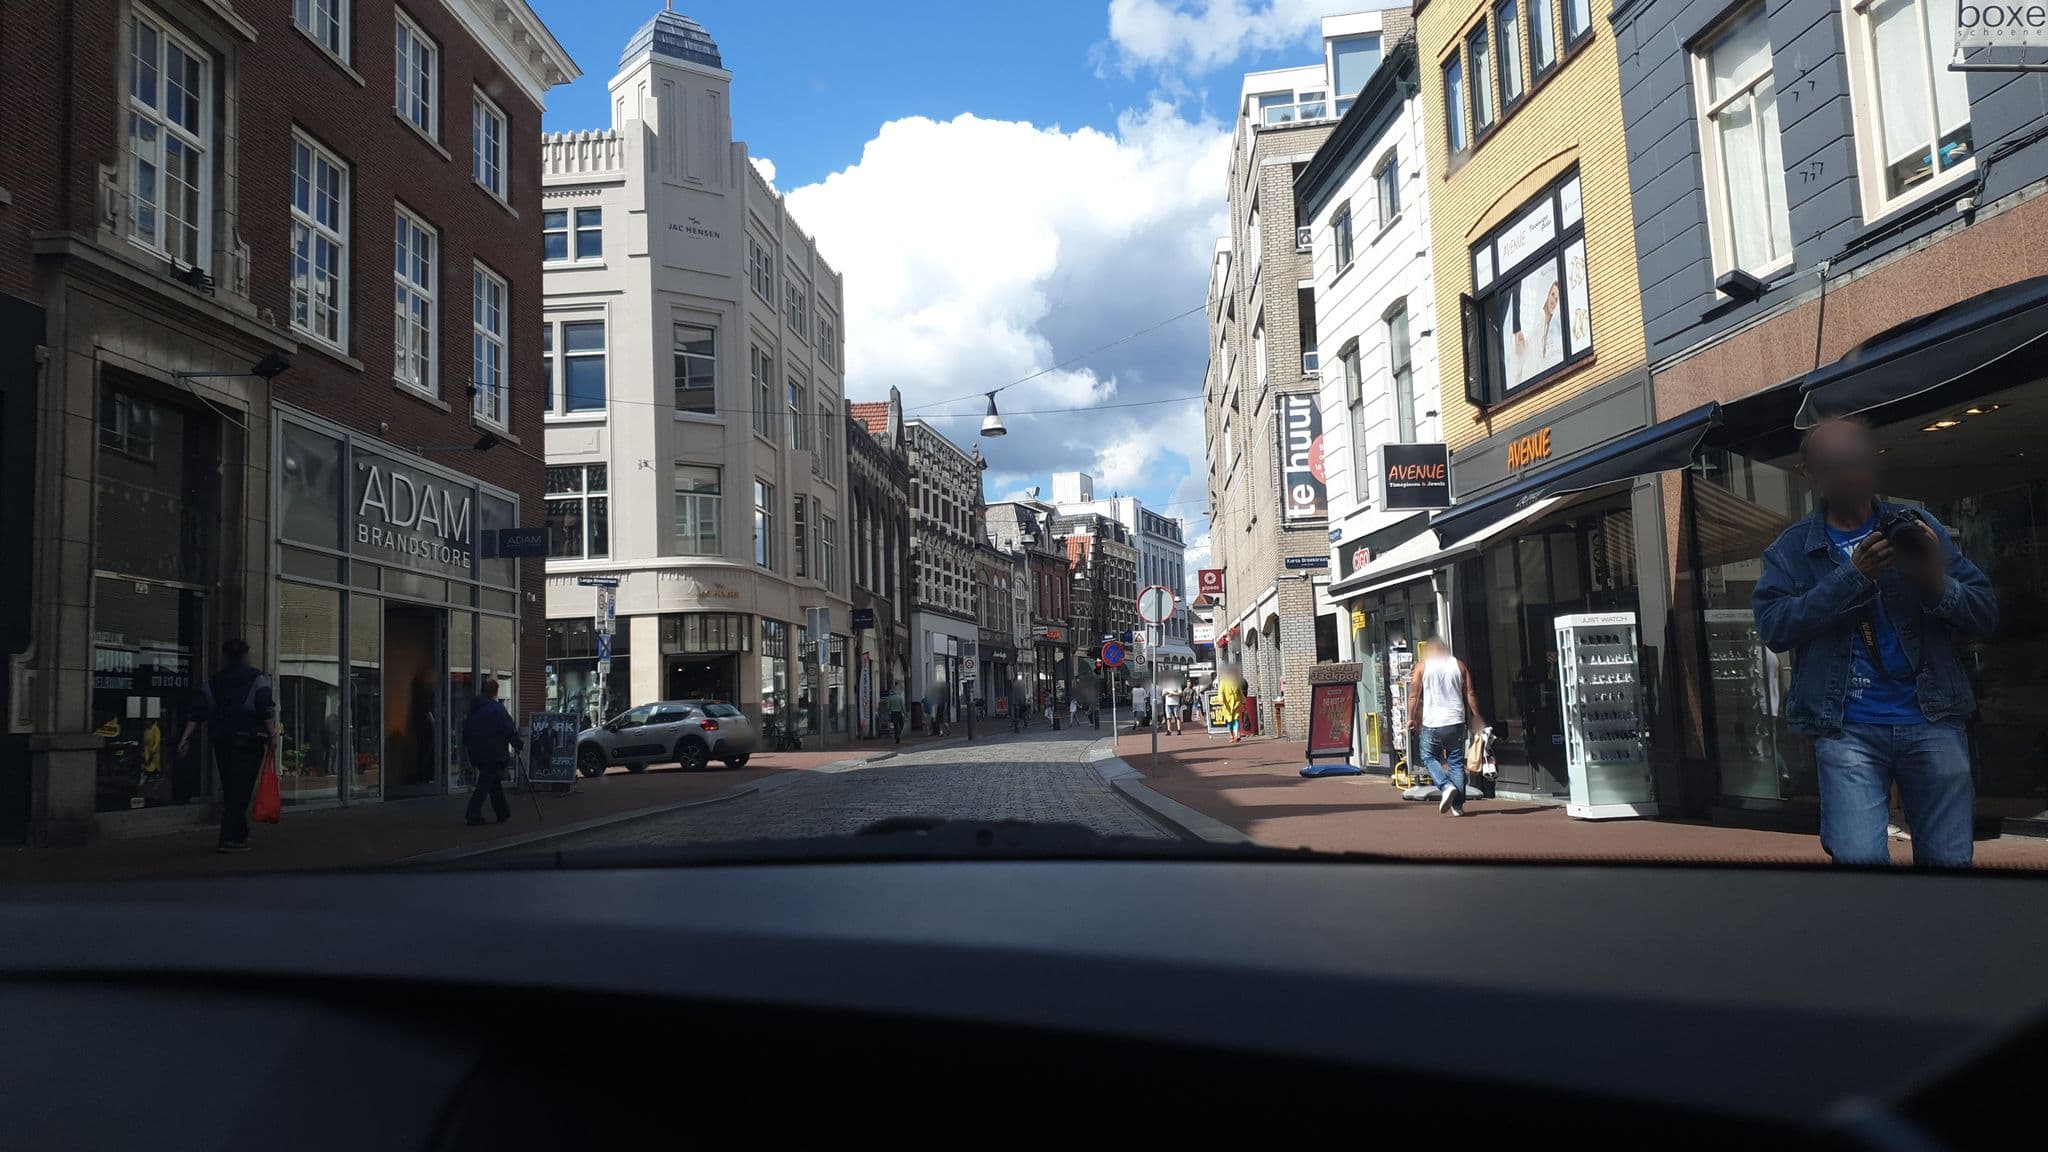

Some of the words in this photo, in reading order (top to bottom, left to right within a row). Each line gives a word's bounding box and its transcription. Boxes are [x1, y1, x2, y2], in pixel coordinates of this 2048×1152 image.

[668, 223, 683, 232] JAC
[686, 226, 720, 239] HENSEN
[1287, 395, 1313, 473] huur
[1507, 429, 1552, 472] AVENUE
[1388, 464, 1445, 481] AVENUE
[358, 465, 471, 544] ADAM
[1288, 484, 1316, 518] te
[357, 523, 471, 569] BRANDSTORE
[506, 535, 543, 546] ADAM
[1862, 623, 1874, 646] Nikon
